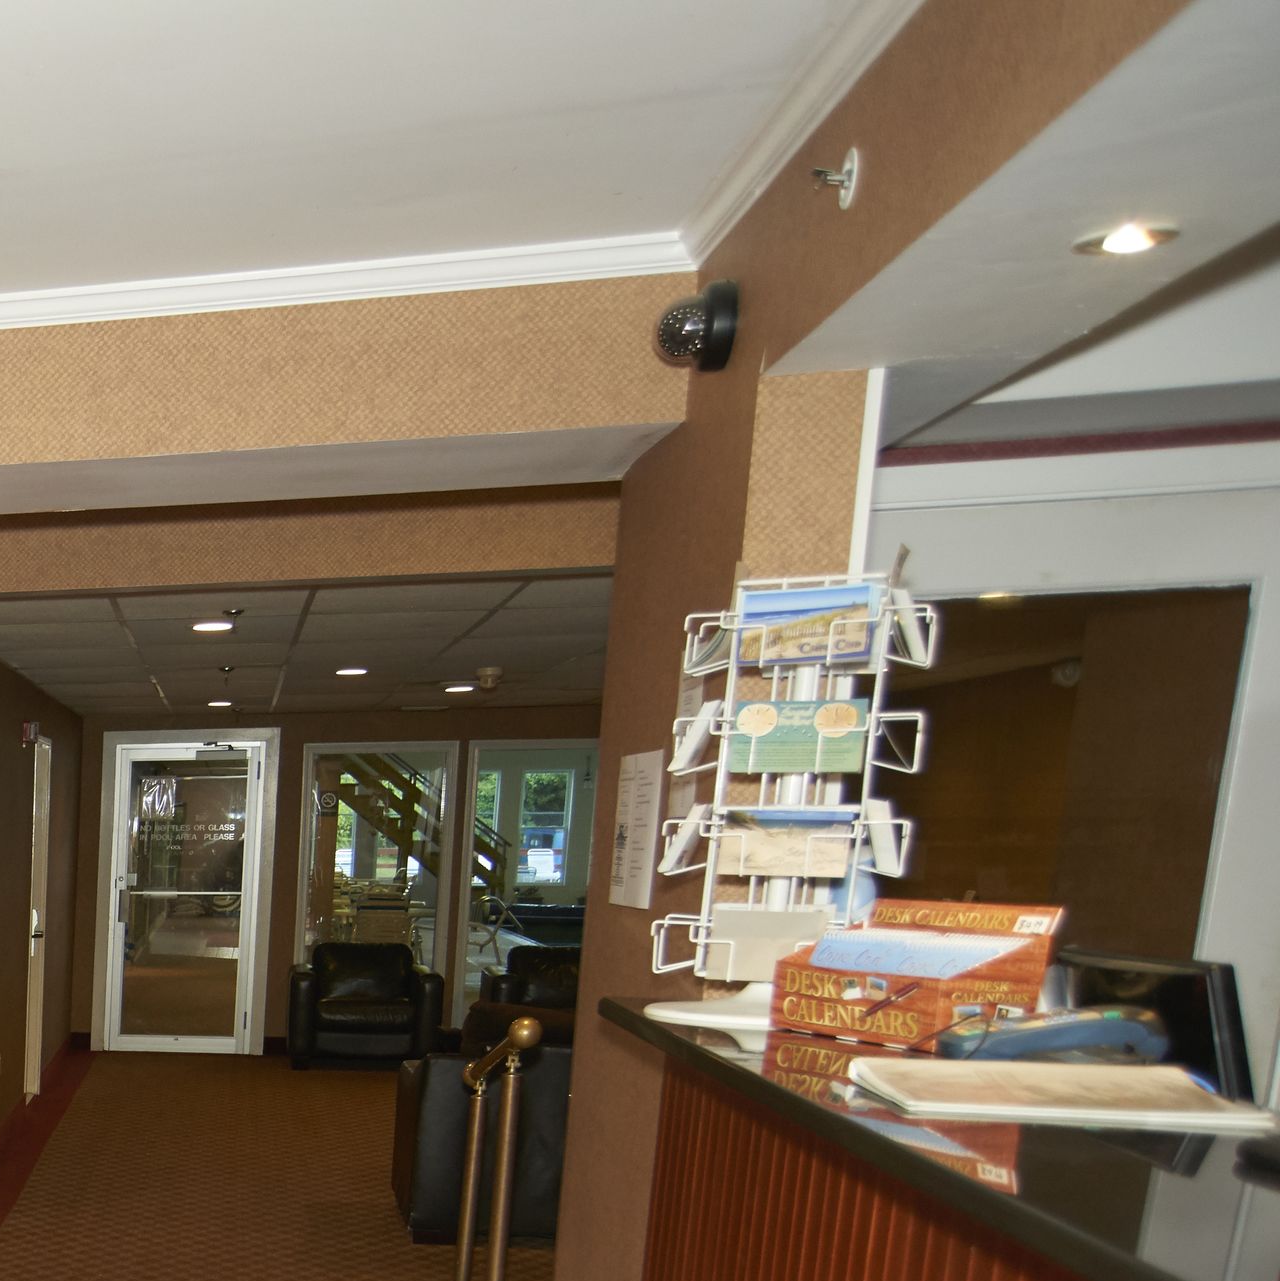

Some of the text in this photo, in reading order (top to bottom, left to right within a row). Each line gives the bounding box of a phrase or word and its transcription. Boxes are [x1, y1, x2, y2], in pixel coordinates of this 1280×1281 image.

[873, 908, 1012, 930] DESK CALENDARS
[784, 969, 839, 999] DESK
[974, 980, 1010, 992] DESK
[951, 992, 1030, 1003] CALENDARS
[783, 997, 918, 1038] CALENDARS
